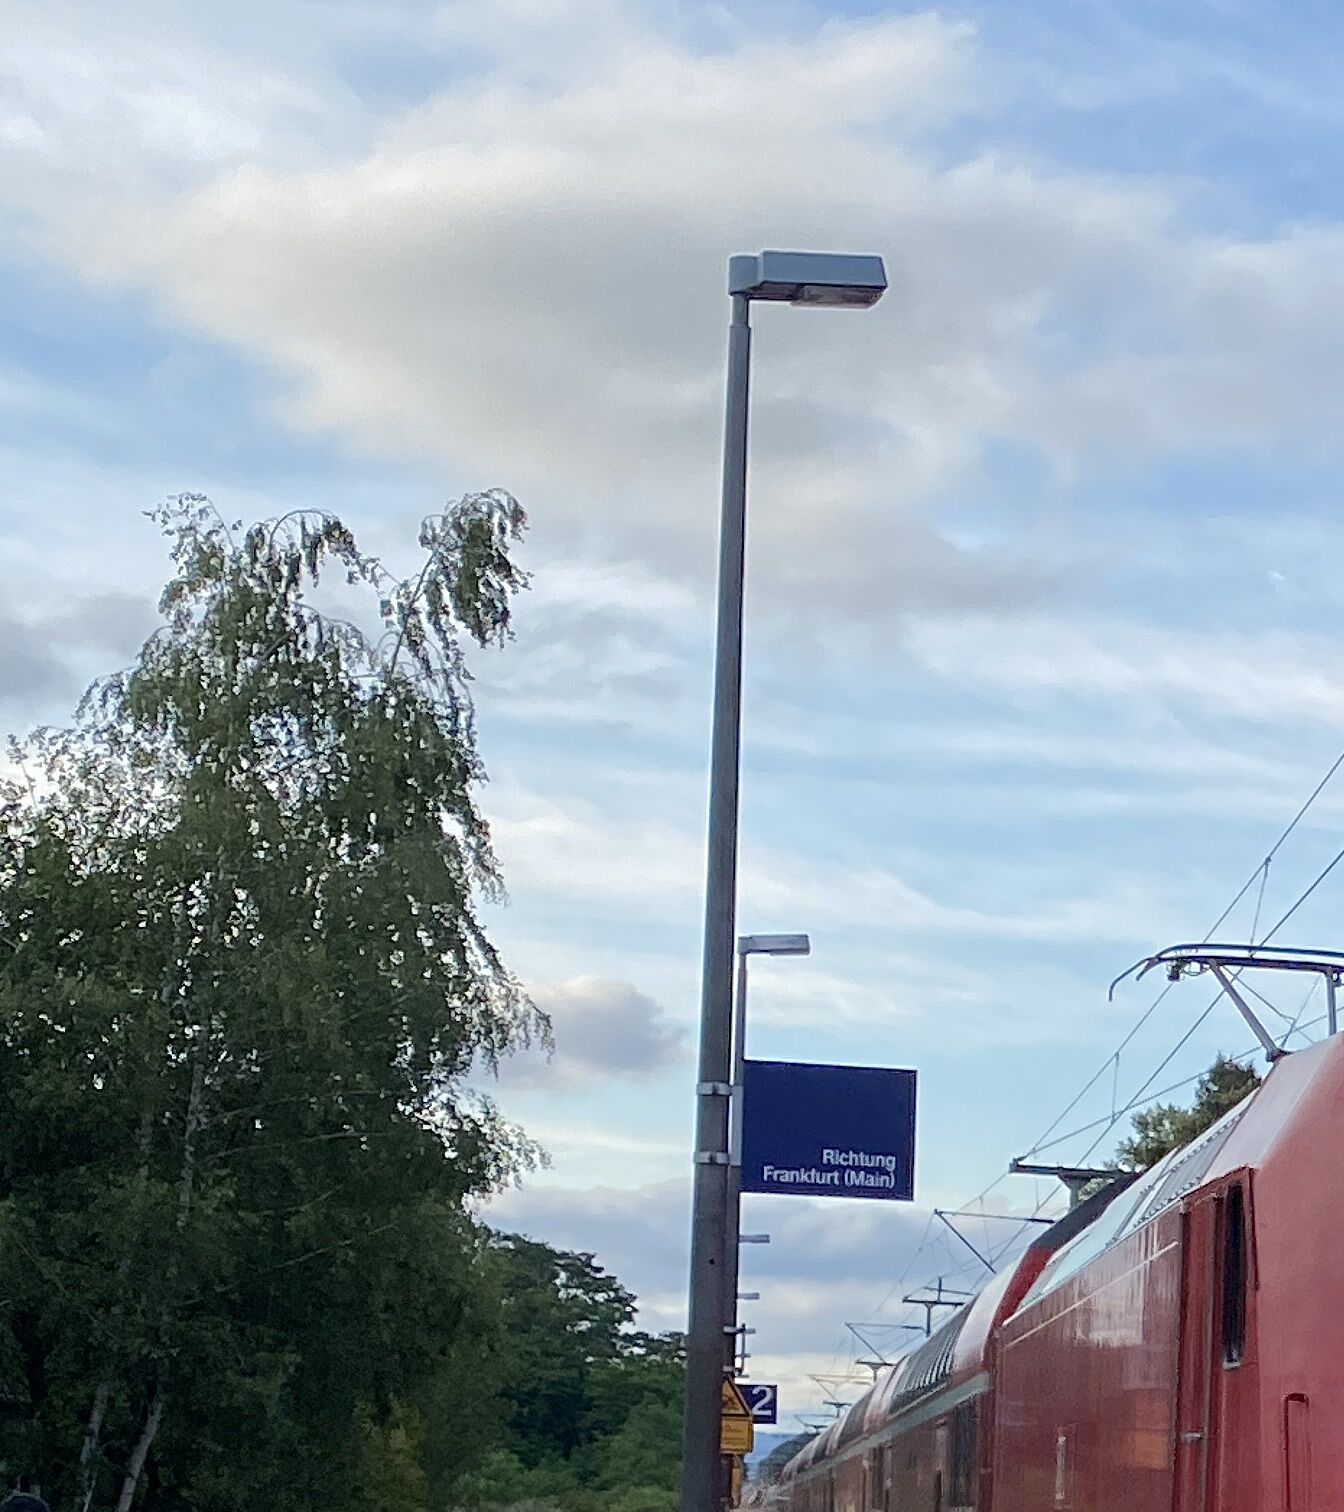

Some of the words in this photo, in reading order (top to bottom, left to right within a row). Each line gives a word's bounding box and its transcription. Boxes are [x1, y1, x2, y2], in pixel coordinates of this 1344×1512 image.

[822, 1149, 896, 1172] Richtung
[763, 1166, 840, 1185] Frankfurt
[844, 1171, 895, 1188] (Main)
[752, 1385, 774, 1416] 2
